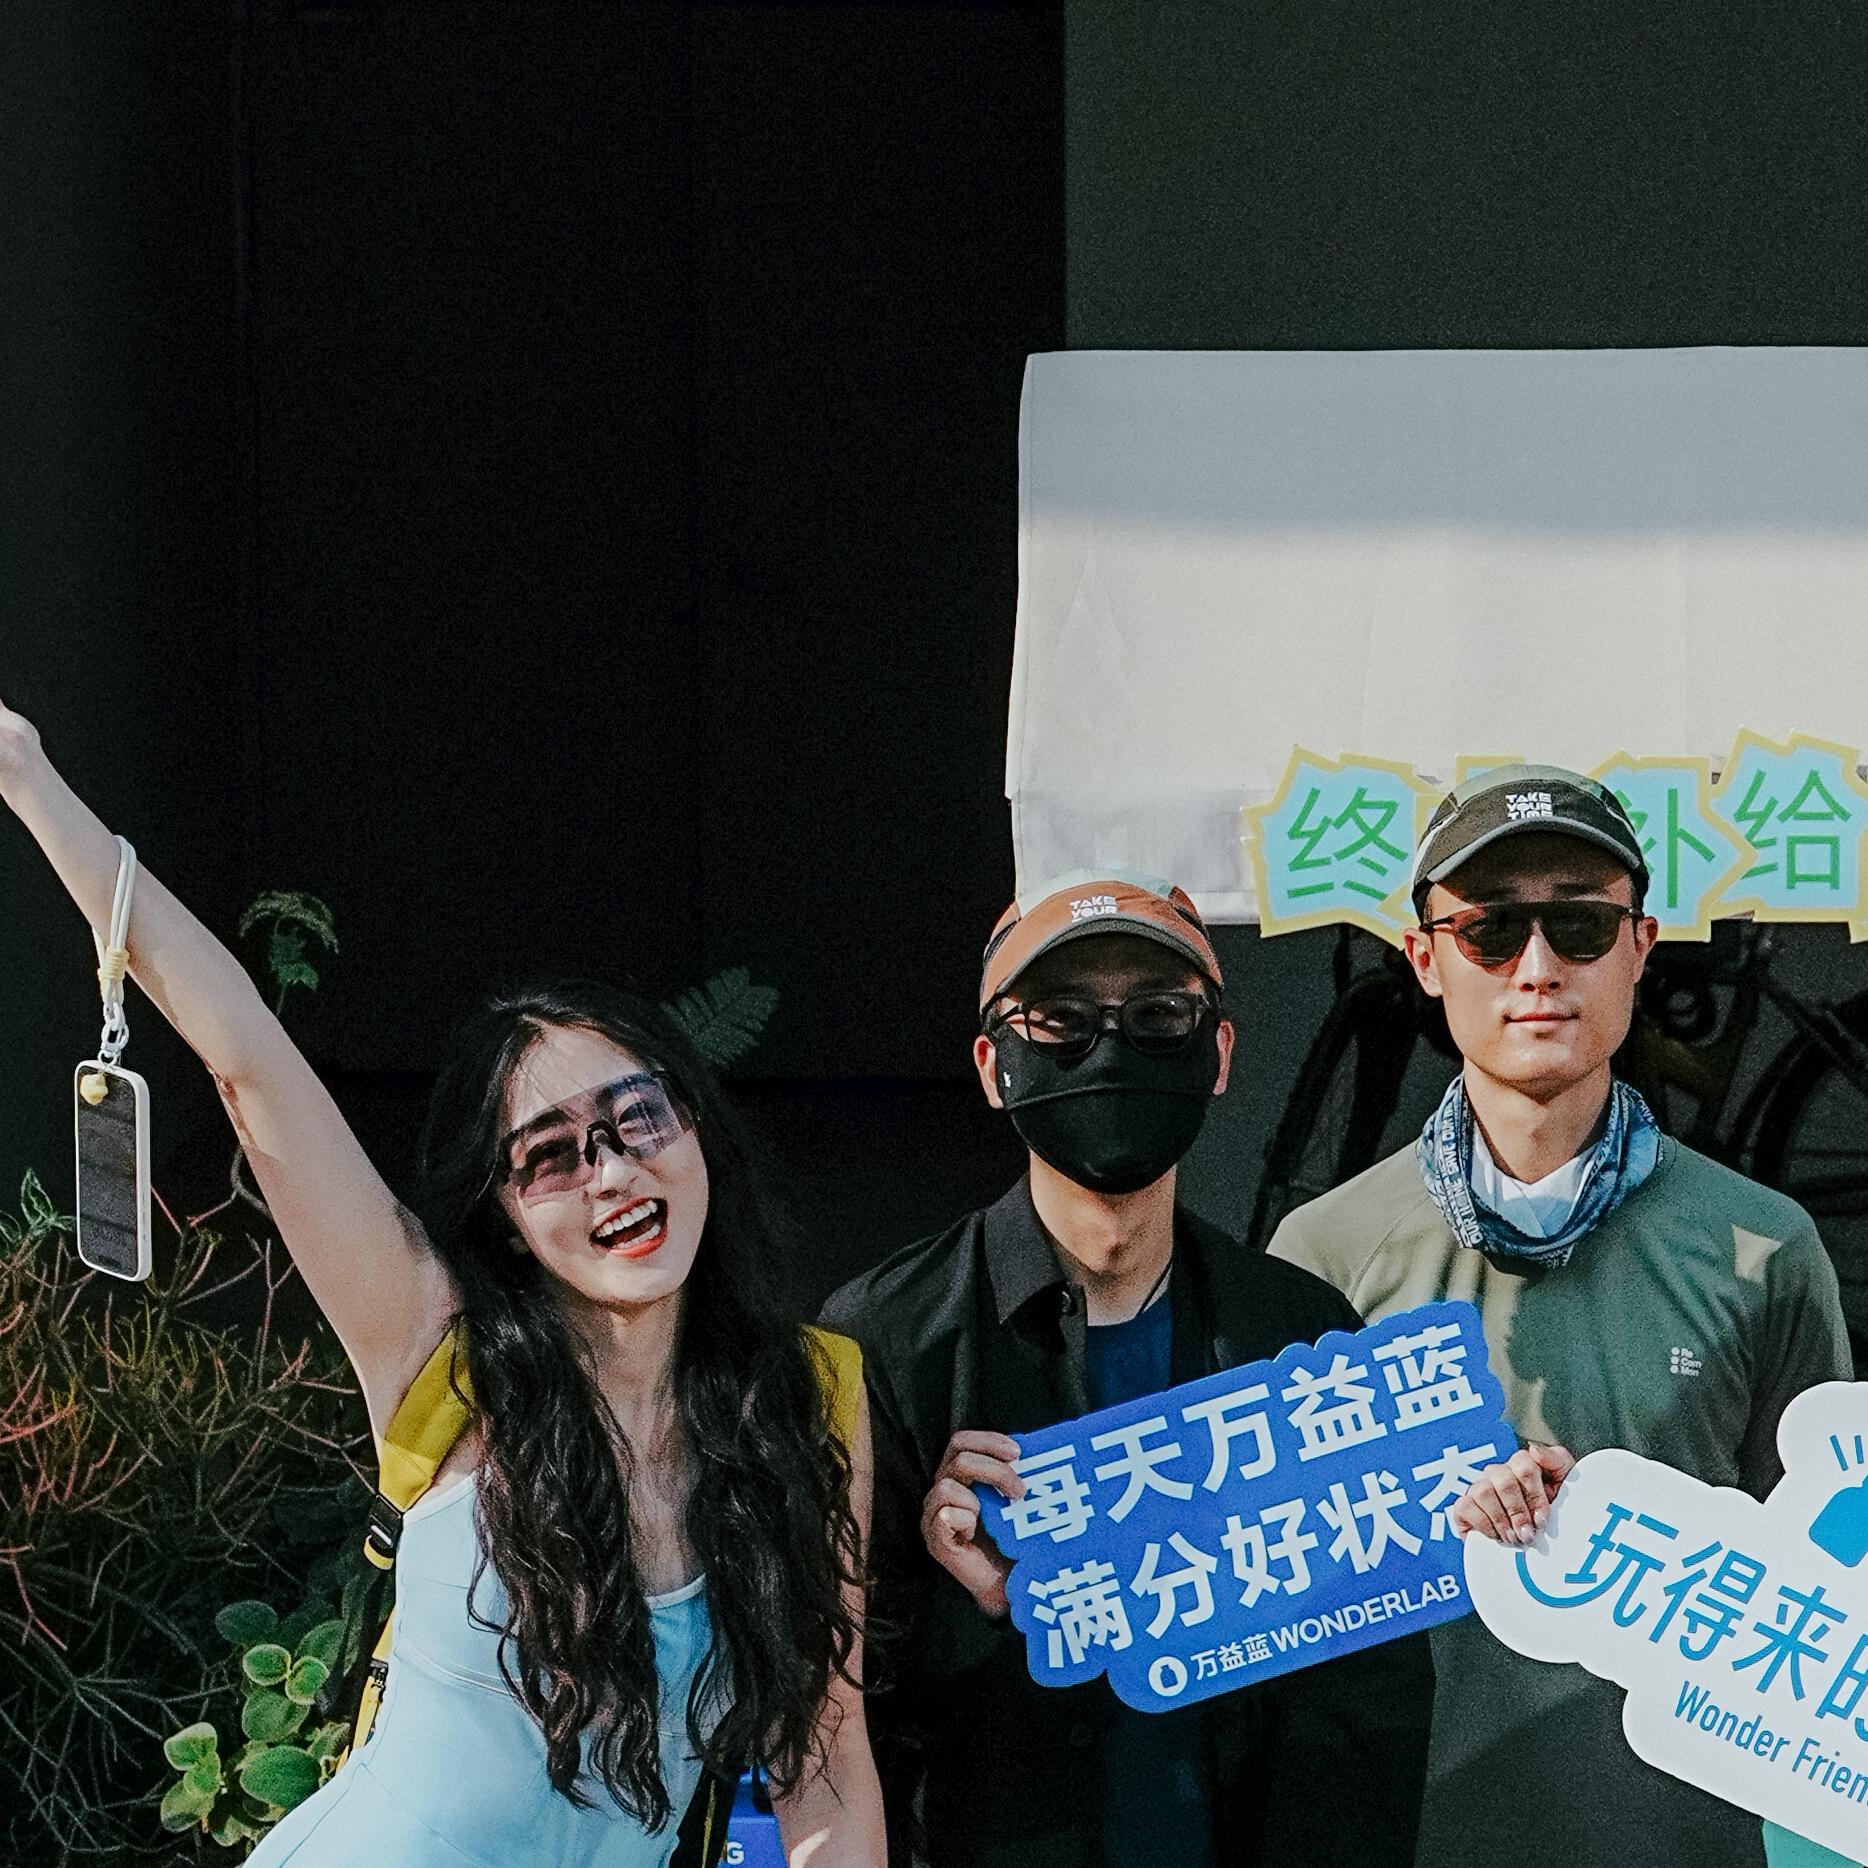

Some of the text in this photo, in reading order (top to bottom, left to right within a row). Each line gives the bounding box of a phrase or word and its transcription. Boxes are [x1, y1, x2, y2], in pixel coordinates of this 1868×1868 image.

[1505, 792, 1552, 803] TAKE
[1506, 802, 1553, 812] YOUR
[1070, 895, 1116, 909] TAKE
[1071, 905, 1118, 918] YOUR
[1001, 1323, 1482, 1543] 每天万益蓝
[1191, 1574, 1461, 1681] 万益蓝 WONDERLAB
[1674, 1680, 1790, 1763] Wonder
